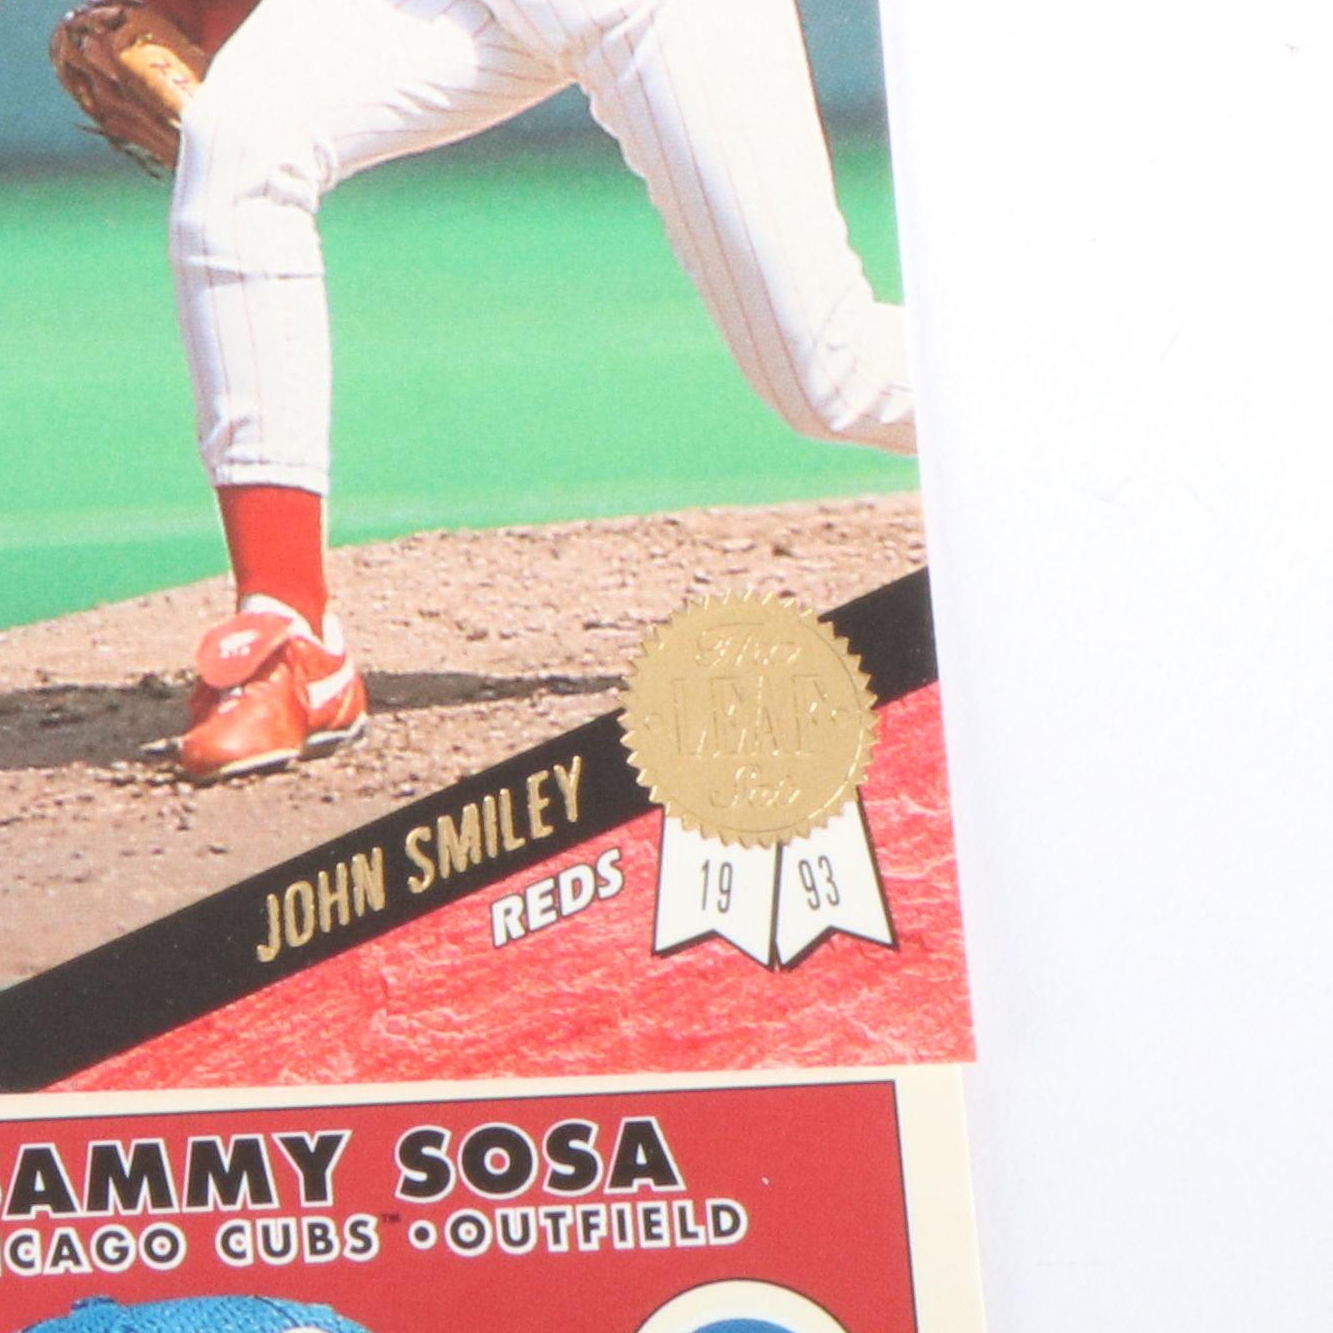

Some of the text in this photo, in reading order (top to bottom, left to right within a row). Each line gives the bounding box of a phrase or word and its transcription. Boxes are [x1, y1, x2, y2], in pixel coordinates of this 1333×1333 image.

[670, 674, 831, 760] LEAF
[256, 755, 583, 965] JOHN SMILEY
[490, 847, 625, 949] REDS
[700, 854, 840, 913] 19 93
[395, 1117, 688, 1205] SOSA
